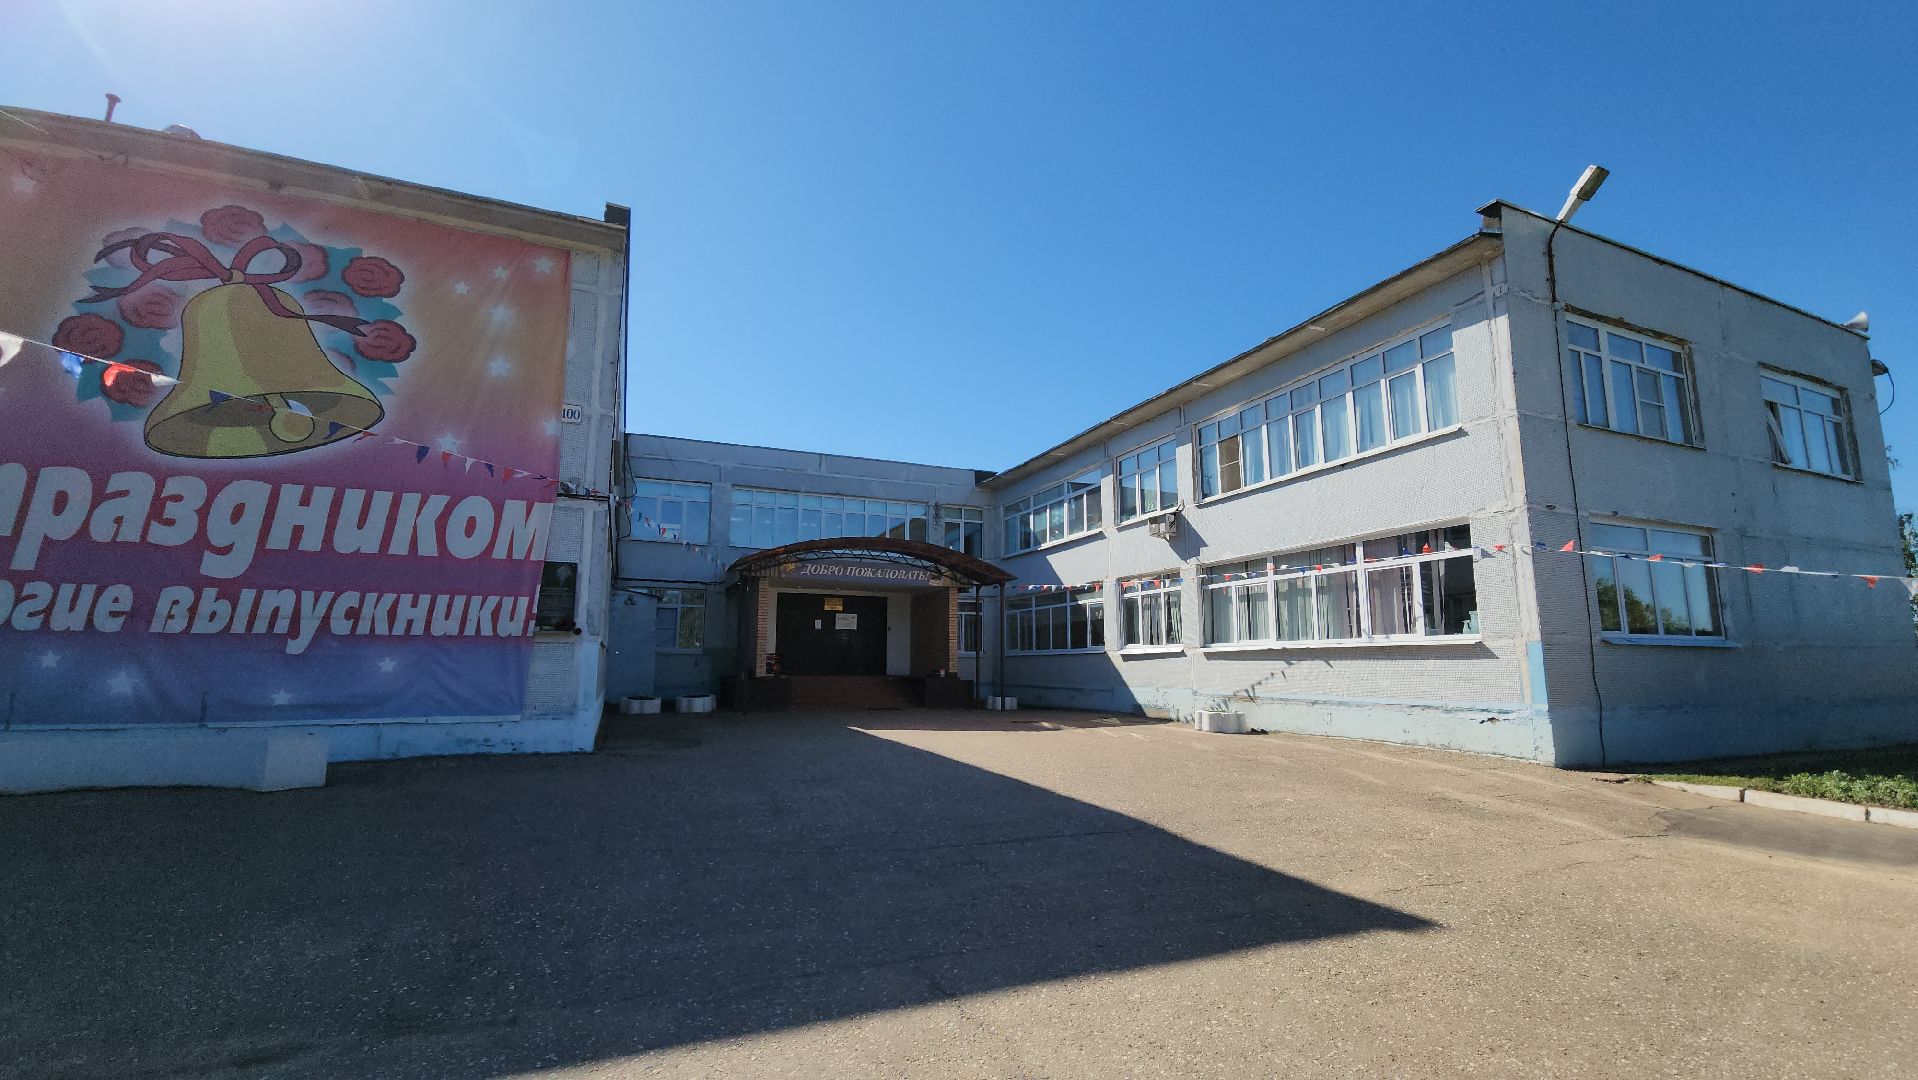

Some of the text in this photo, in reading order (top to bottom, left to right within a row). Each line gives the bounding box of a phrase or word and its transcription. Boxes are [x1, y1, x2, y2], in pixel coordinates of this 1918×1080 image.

[562, 408, 581, 420] 100
[801, 563, 931, 581] ДОБРО ПОЖАЛОВАТЬ!
